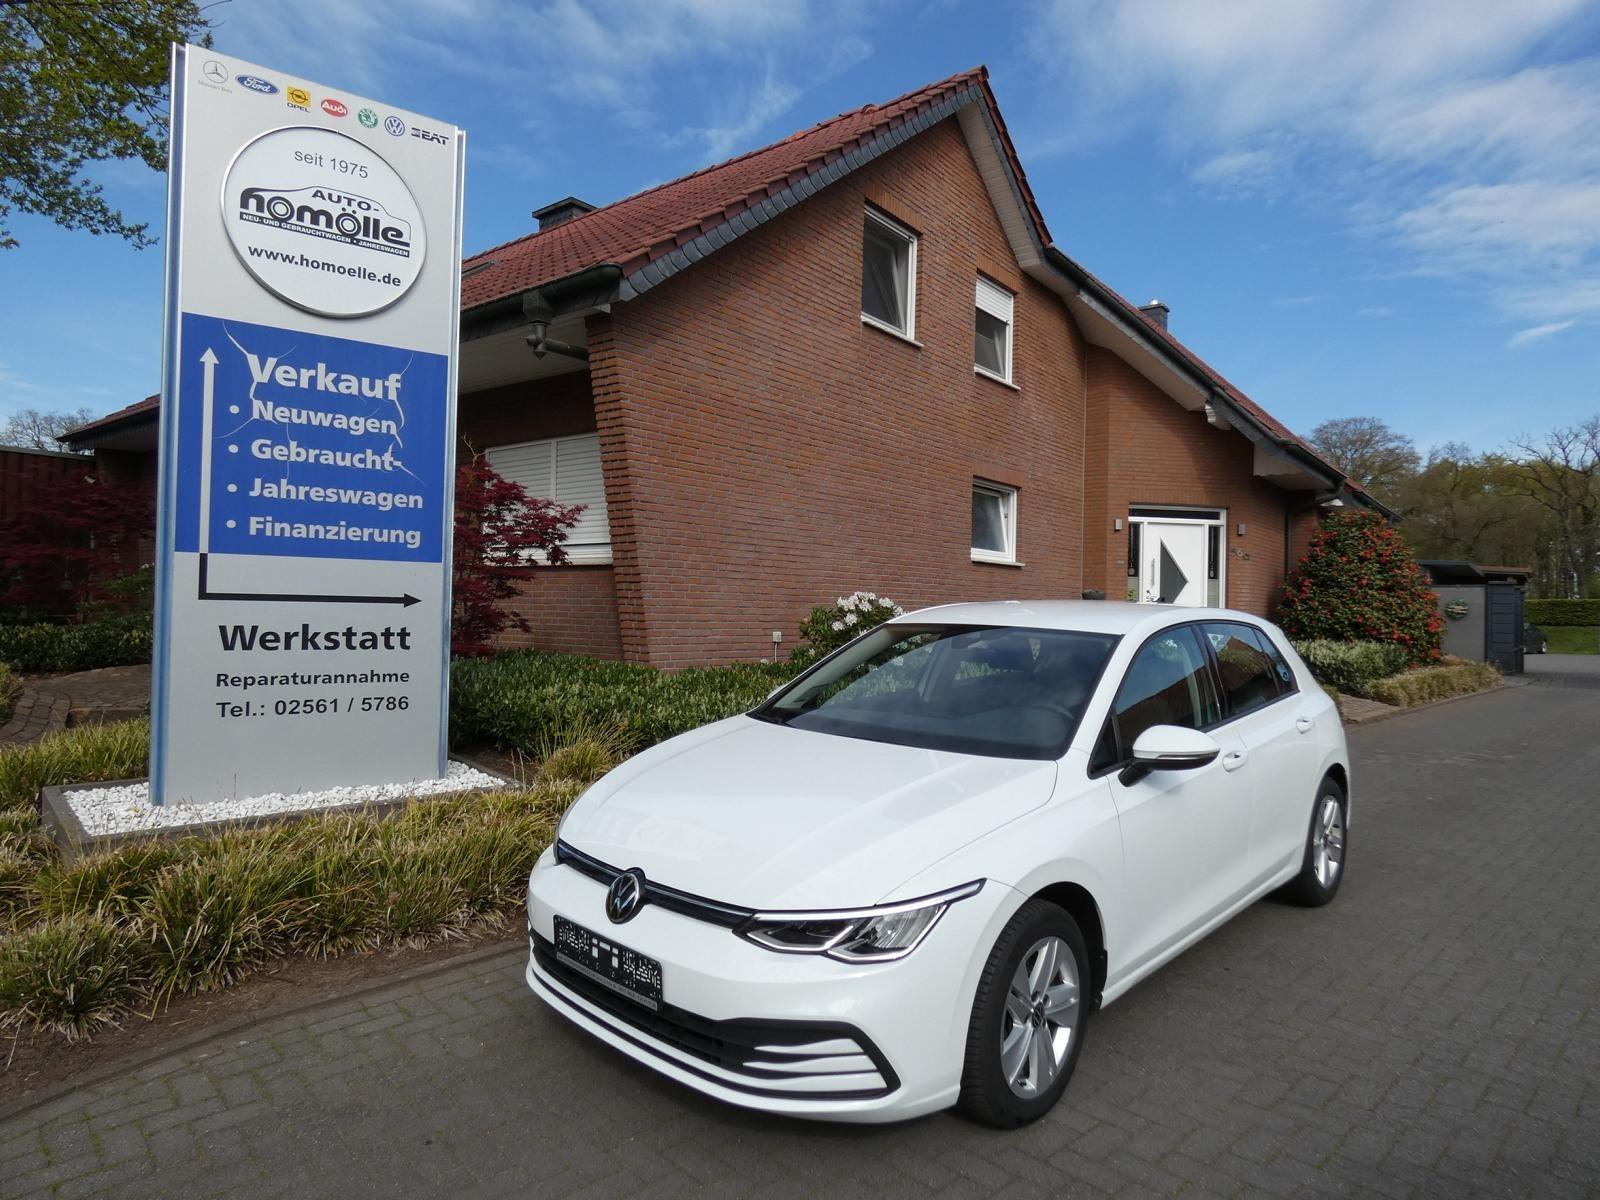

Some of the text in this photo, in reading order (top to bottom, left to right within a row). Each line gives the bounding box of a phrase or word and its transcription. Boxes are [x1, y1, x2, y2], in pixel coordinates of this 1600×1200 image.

[243, 77, 271, 93] Ford
[286, 102, 311, 113] OPEL
[321, 101, 347, 114] Audi
[411, 127, 449, 145] SEAT
[294, 150, 368, 178] seit 1975
[312, 189, 379, 211] AUTO-
[242, 213, 408, 257] NEU- UND GEBRAUCHTWAGEN JAHRESWAGEN
[248, 246, 401, 287] www.homoelle.de
[247, 353, 401, 400] Verkauf
[252, 399, 397, 435] Neuwagen
[251, 438, 402, 471] Gebraucht-
[249, 478, 423, 511] Jahreswagen
[249, 516, 421, 549] Finanzierung
[218, 623, 411, 651] Werkstatt
[216, 669, 410, 690] Reparaturannahme
[216, 696, 409, 718] Tel.: 02561 / 5786
